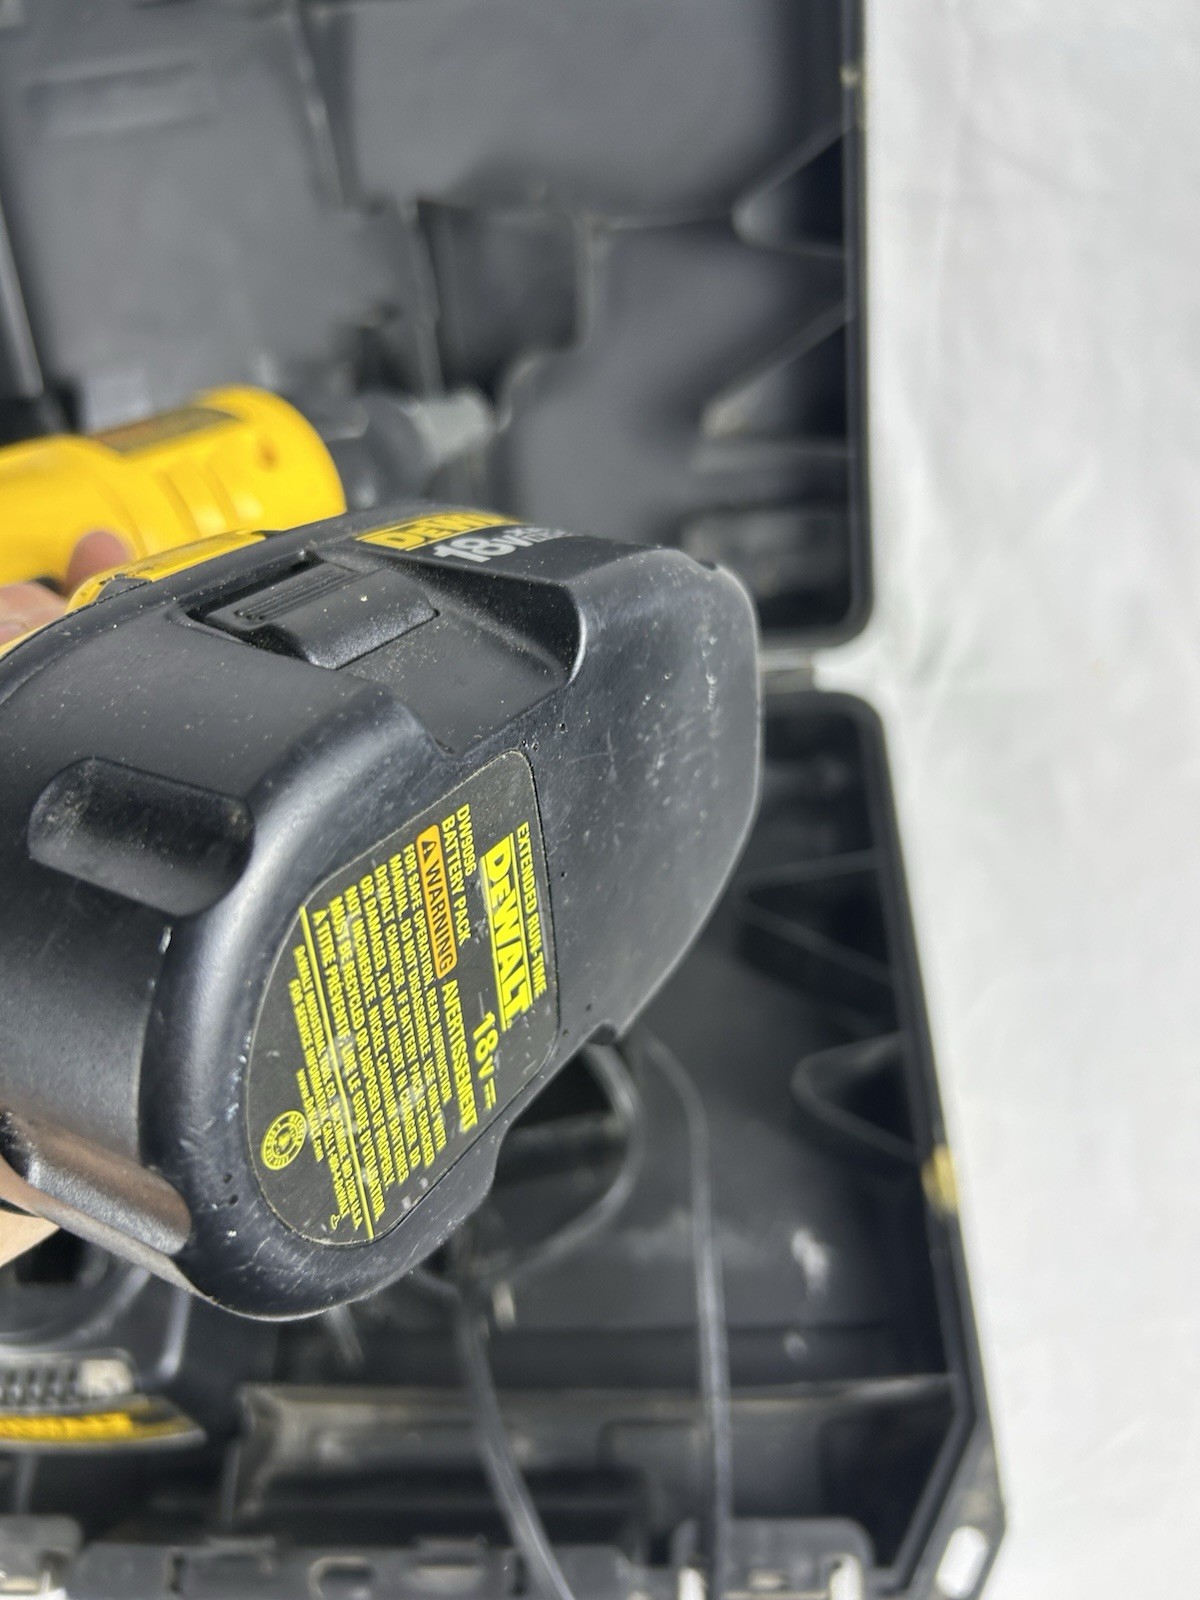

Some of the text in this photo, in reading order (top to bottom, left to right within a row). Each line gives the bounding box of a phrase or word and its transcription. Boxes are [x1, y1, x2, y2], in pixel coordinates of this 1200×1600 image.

[402, 842, 418, 876] FOR
[455, 802, 477, 879] DW9096
[358, 873, 375, 902] OR
[406, 870, 423, 912] SAFE
[441, 813, 471, 947] BATTERY PACK
[424, 858, 454, 973] WARNING
[516, 820, 546, 1000] EXTENDED RUN-TIME
[314, 920, 336, 970] TITRE
[383, 920, 406, 995] CHARGER.
[287, 976, 304, 1007] FOR
[376, 971, 392, 999] DO
[388, 852, 447, 1152] MANUAL. DO NOT DISASSEMBLE. USE ONLY WITH
[395, 988, 409, 1008] IF
[425, 985, 441, 1026] READ
[293, 1000, 313, 1051] SERVICE
[343, 883, 410, 1186] NOT INCINERATE. NICKEL CADMIUM BATTERIES
[380, 993, 397, 1029] NOT
[398, 1002, 418, 1065] BATTERY
[328, 894, 397, 1192] MUST BE RECYCLED OR DISPOSED OF PROPERLY.
[339, 1040, 358, 1078] LIRE
[385, 1022, 405, 1075] INSERT
[430, 1020, 453, 1104] INSTRUCTION
[440, 975, 478, 1135] AVERTISSEMENT
[346, 1070, 362, 1095] LE
[394, 1069, 408, 1092] IN
[408, 1060, 425, 1101] PACK
[414, 1095, 427, 1114] IS
[303, 987, 328, 1058] INDUSTRIAL
[317, 1051, 334, 1085] TOOL
[341, 1155, 354, 1180] MD
[350, 1197, 365, 1230] U.S.A.
[349, 1088, 370, 1135] GUIDE
[397, 1085, 419, 1151] CHARGER.
[320, 1119, 335, 1150] CALL
[408, 1144, 422, 1170] DO
[416, 1107, 436, 1168] CRACKED
